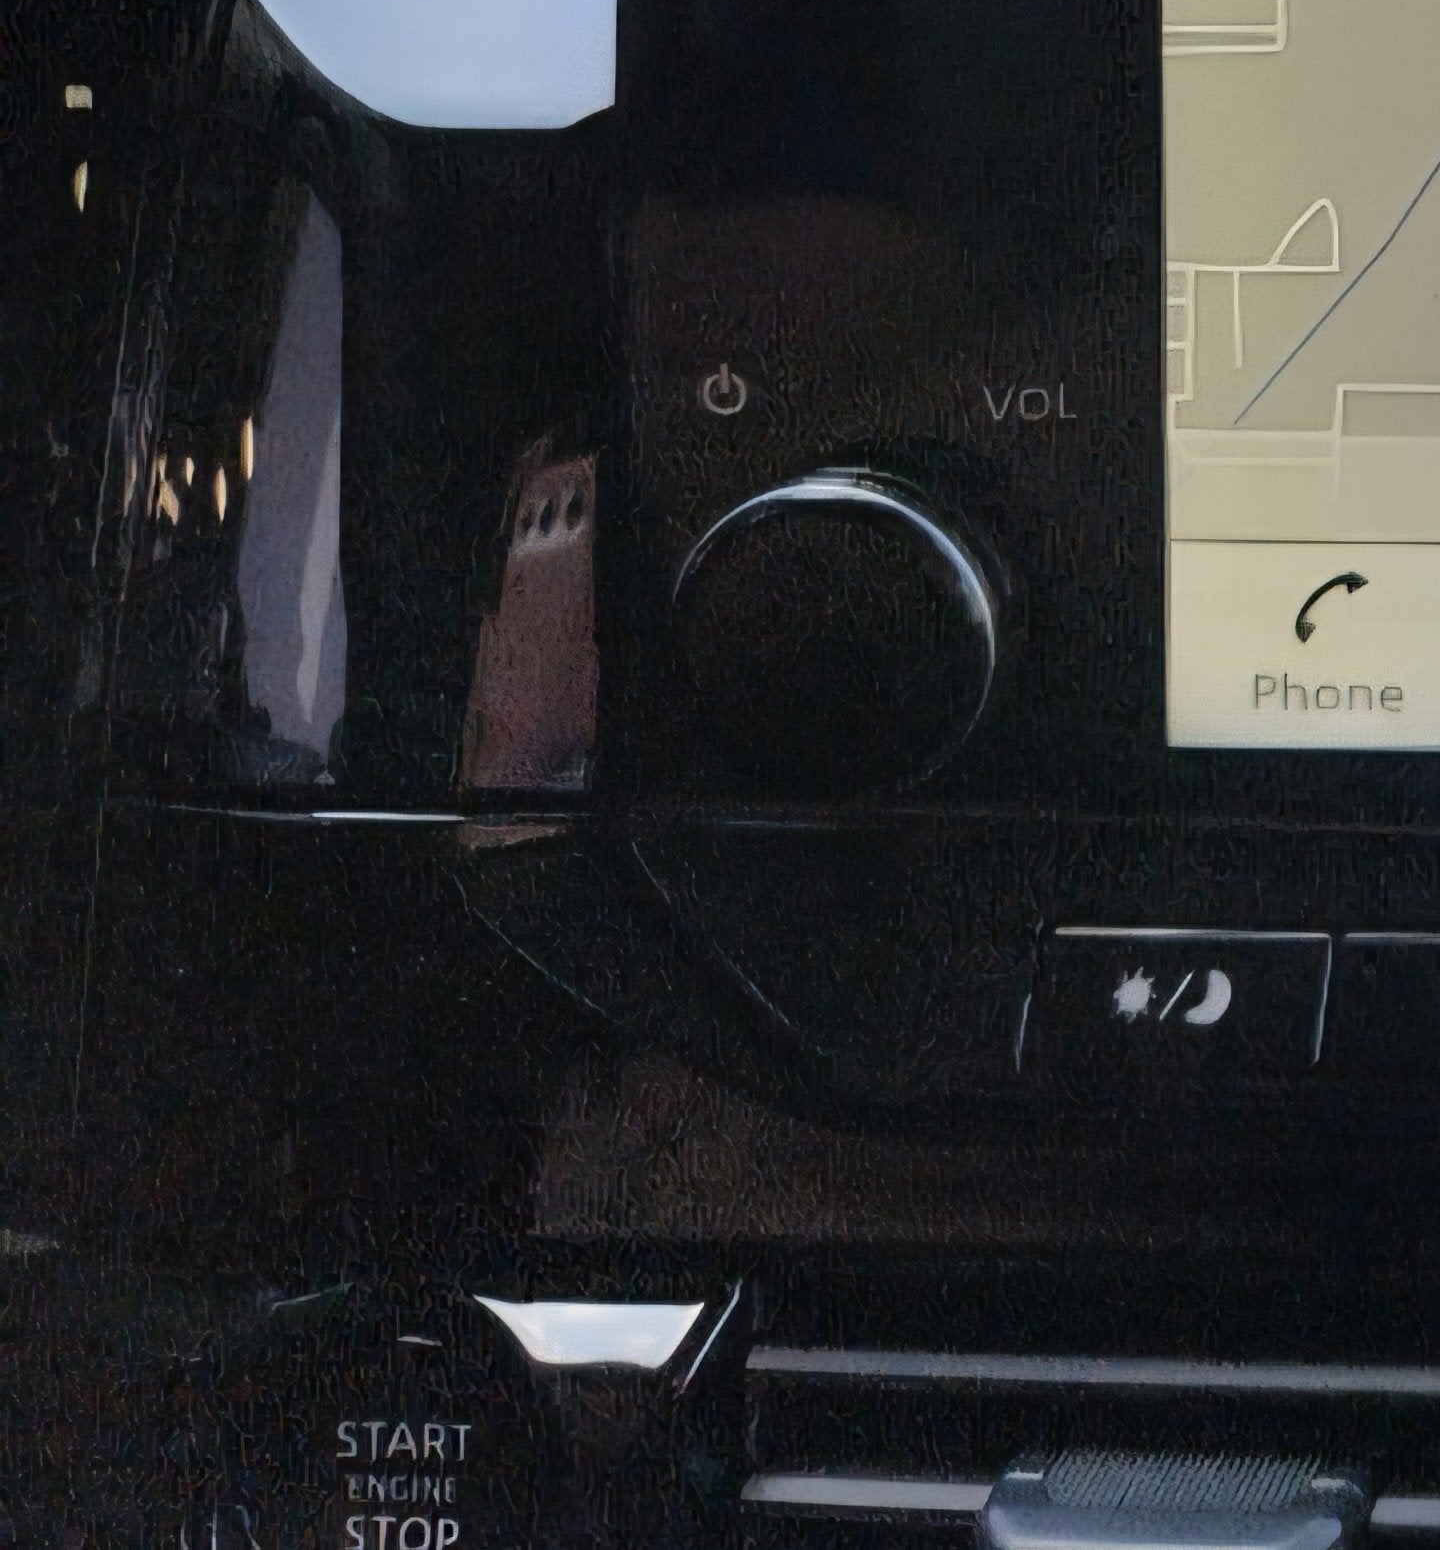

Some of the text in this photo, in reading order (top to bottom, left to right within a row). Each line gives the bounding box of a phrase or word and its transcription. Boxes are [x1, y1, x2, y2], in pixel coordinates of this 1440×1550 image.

[982, 381, 1078, 421] VOL
[1253, 671, 1404, 714] Phone
[336, 1420, 472, 1462] START
[345, 1515, 460, 1550] STOP
